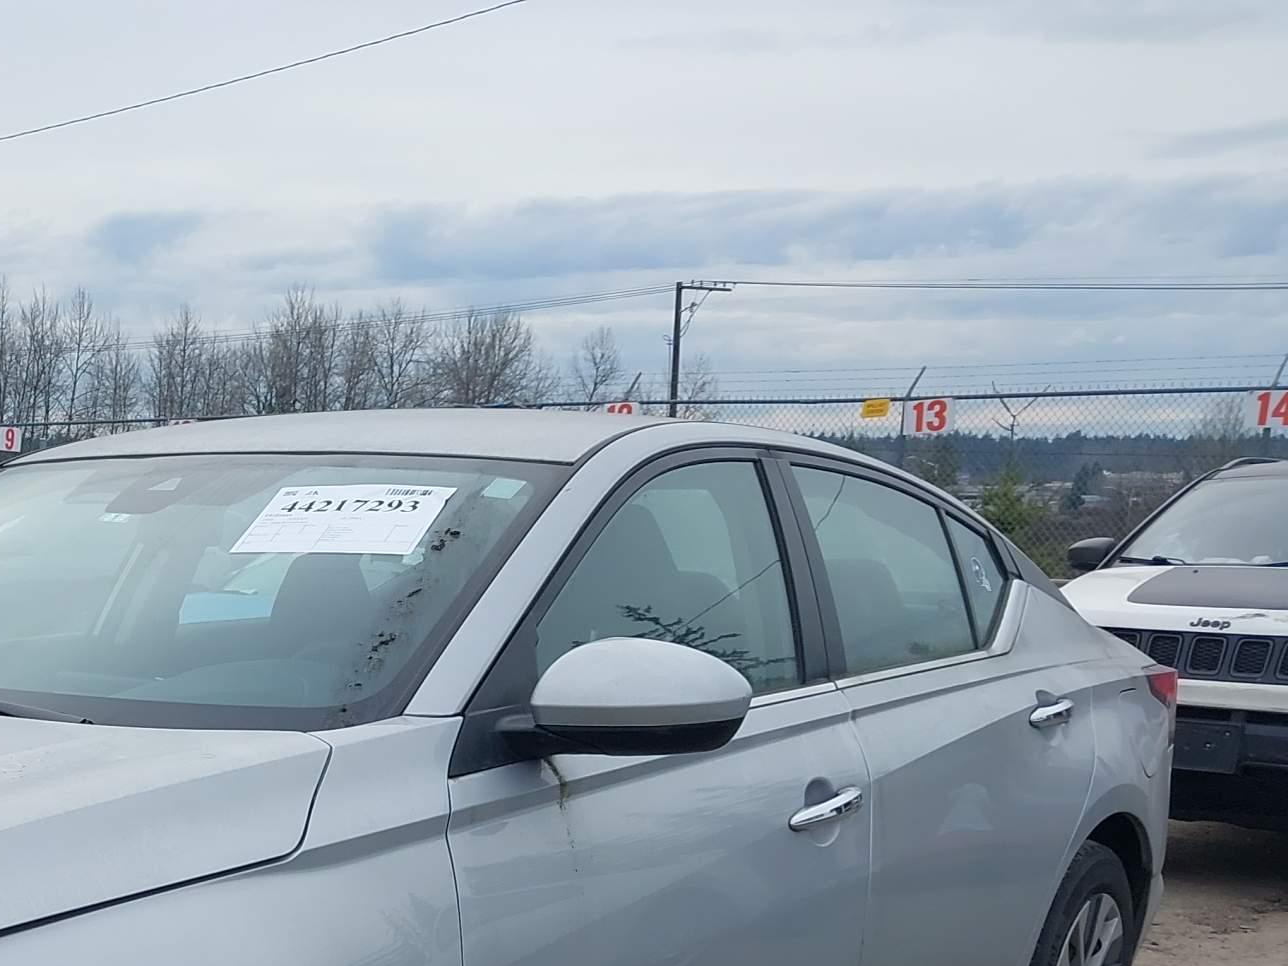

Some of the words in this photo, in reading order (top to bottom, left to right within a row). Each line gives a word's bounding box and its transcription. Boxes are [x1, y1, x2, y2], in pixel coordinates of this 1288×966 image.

[913, 400, 948, 433] 13
[1257, 391, 1288, 426] 14
[5, 428, 15, 450] 9
[279, 498, 421, 513] 44217293
[1189, 617, 1231, 631] Jeep
